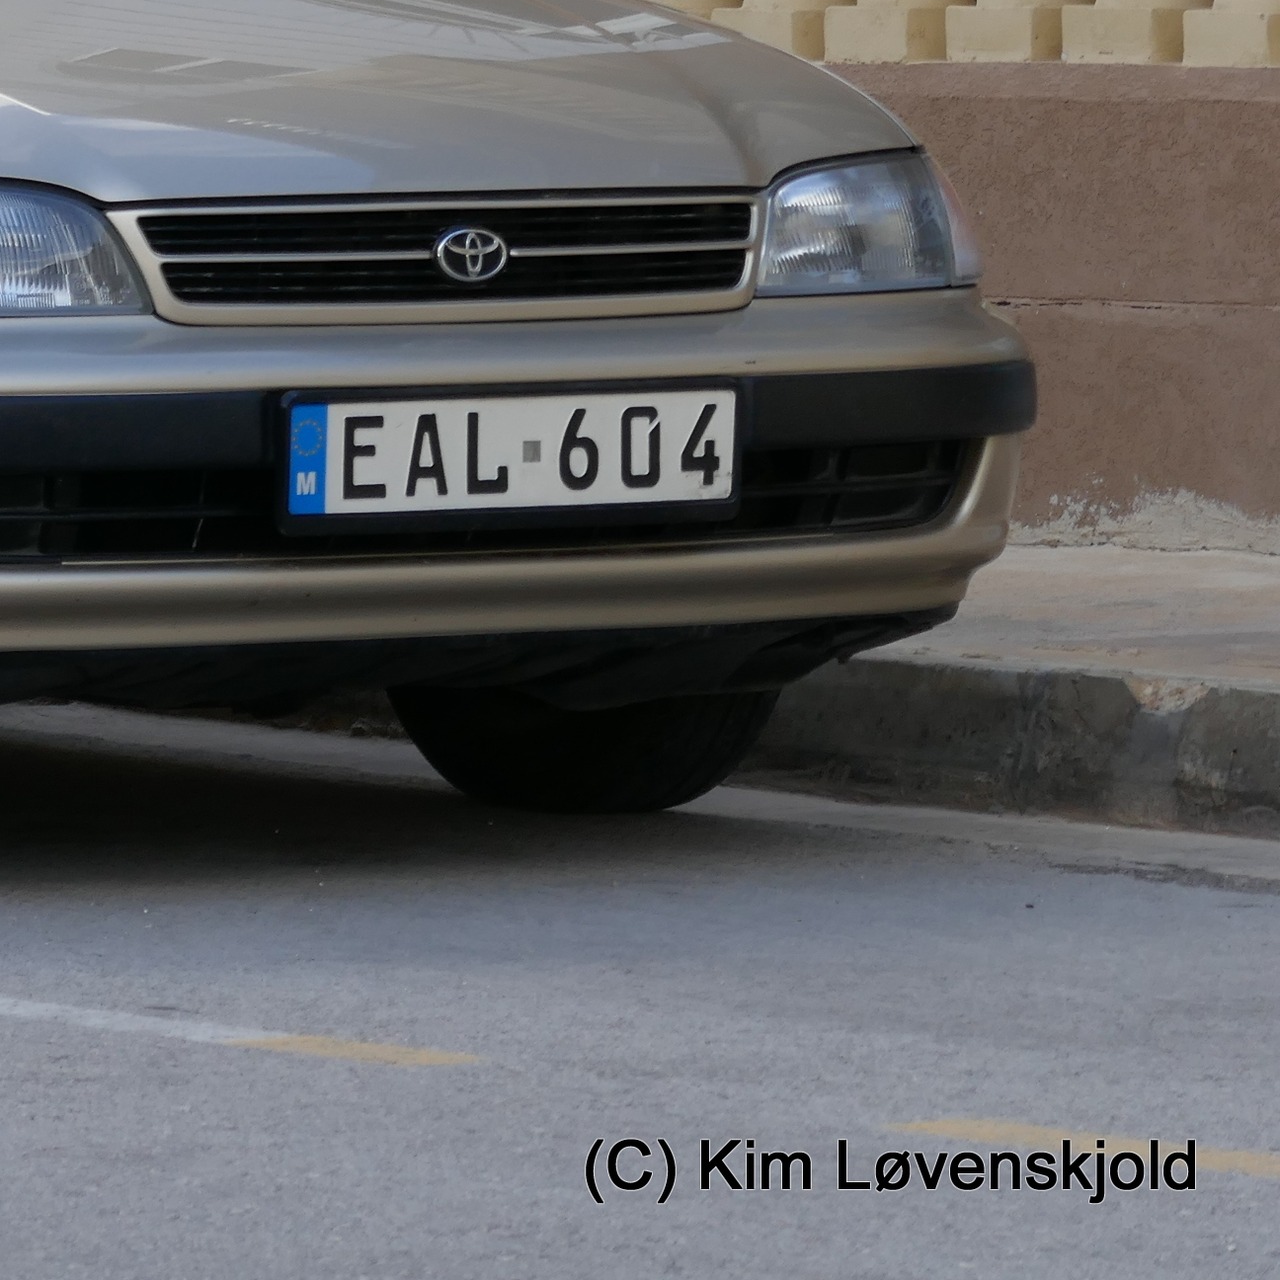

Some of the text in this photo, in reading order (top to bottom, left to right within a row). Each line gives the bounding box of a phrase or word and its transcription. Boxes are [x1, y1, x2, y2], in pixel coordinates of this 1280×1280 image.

[296, 403, 720, 500] M EAL 604
